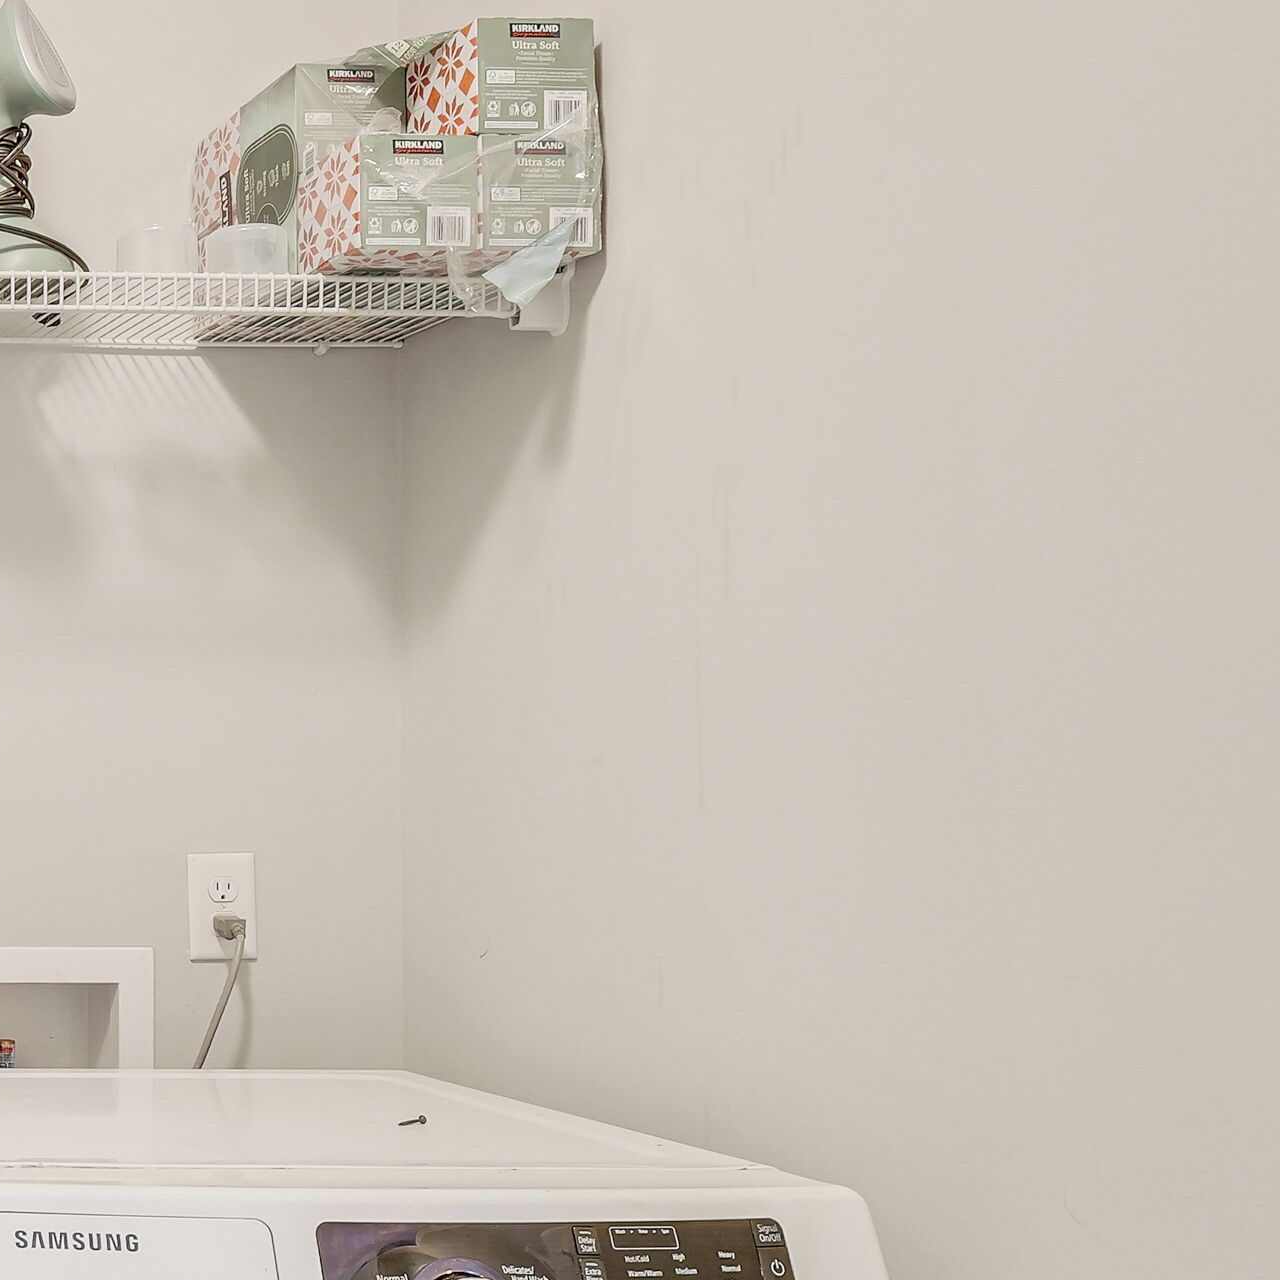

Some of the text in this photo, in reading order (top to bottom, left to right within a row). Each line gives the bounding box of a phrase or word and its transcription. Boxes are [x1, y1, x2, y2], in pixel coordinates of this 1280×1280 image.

[511, 24, 559, 32] KIRKLAND
[512, 41, 560, 50] Ultra Soft
[394, 140, 442, 149] KIRKLAND
[517, 141, 565, 149] KIRKLAND
[394, 157, 443, 166] Ultra Soft
[516, 158, 566, 167] Ultra Soft
[756, 1223, 779, 1234] Signal
[15, 1230, 139, 1252] SAMSUNG
[578, 1236, 596, 1247] Delay
[580, 1244, 596, 1252] Start
[585, 1267, 602, 1275] Extra
